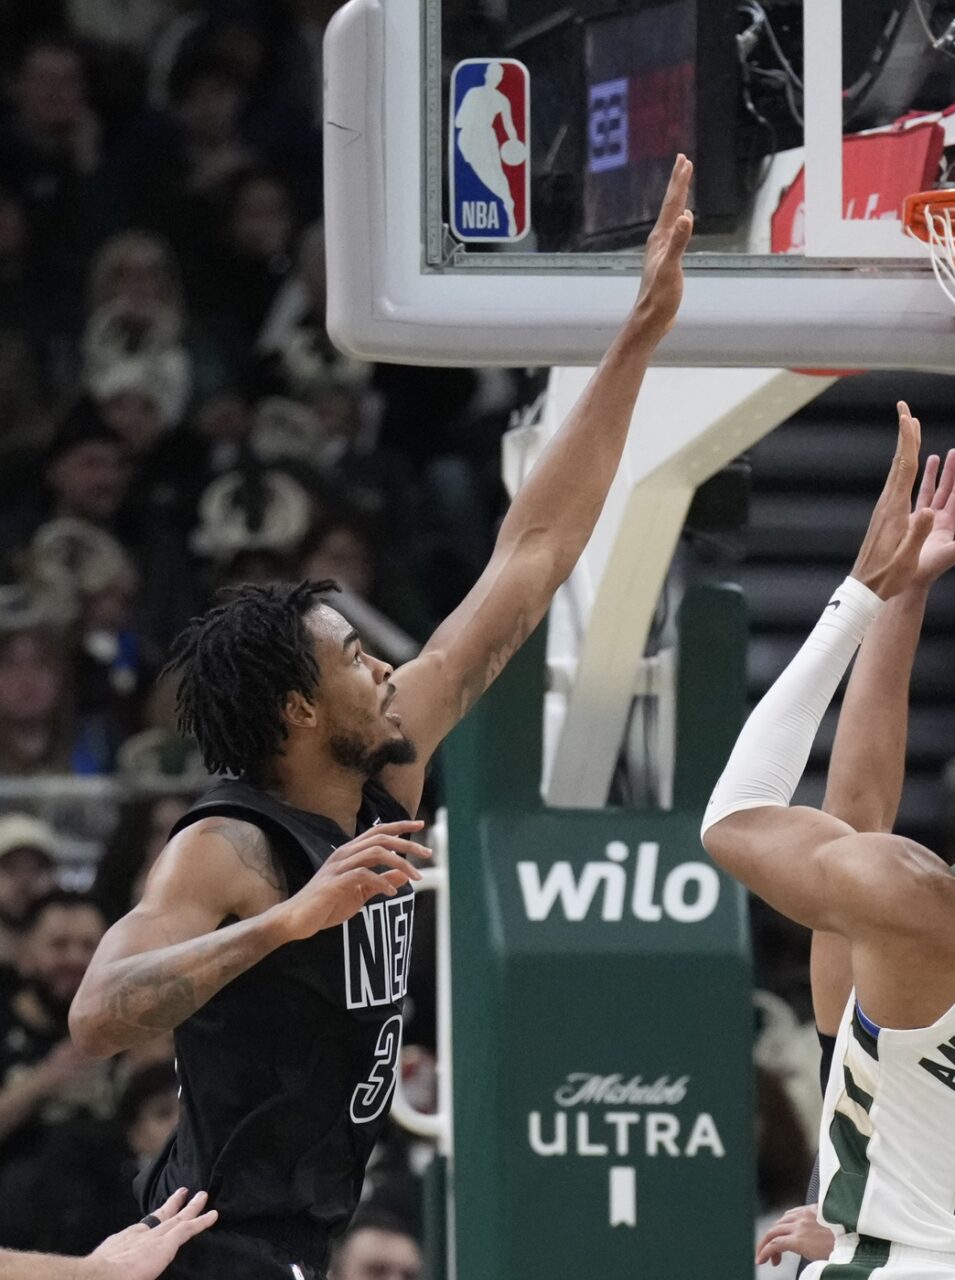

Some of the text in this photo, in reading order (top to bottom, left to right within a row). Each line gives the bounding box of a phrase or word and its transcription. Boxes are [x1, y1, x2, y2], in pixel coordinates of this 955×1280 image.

[461, 200, 500, 230] NBA
[516, 840, 721, 924] wilo
[349, 1012, 404, 1125] 3
[554, 1072, 691, 1107] Michelob
[528, 1110, 726, 1158] ULTRA
